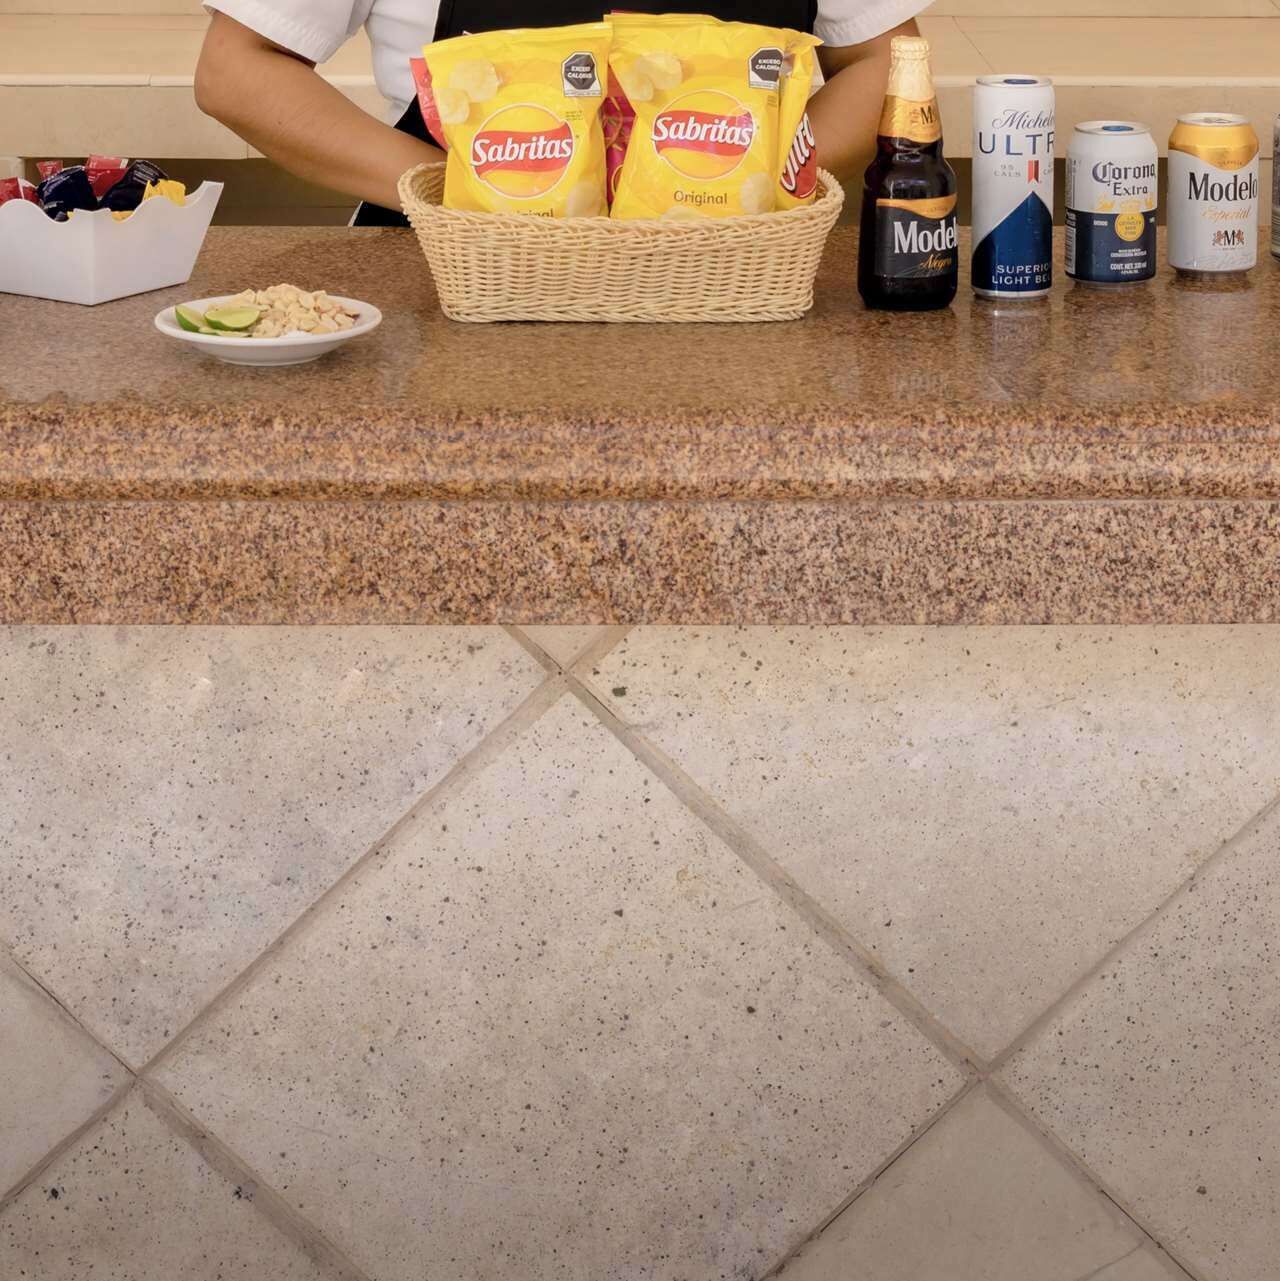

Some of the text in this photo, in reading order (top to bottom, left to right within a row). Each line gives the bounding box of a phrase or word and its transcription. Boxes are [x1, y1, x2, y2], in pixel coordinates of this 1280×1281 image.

[651, 116, 753, 147] Sabritas
[978, 131, 1055, 156] ULTR
[471, 135, 573, 167] Sabritas
[1092, 161, 1156, 186] Corona
[673, 190, 728, 207] Original
[1113, 182, 1148, 196] Extra
[1188, 171, 1258, 202] Modelo
[893, 217, 958, 254] Model
[992, 275, 1030, 285] LIGHT
